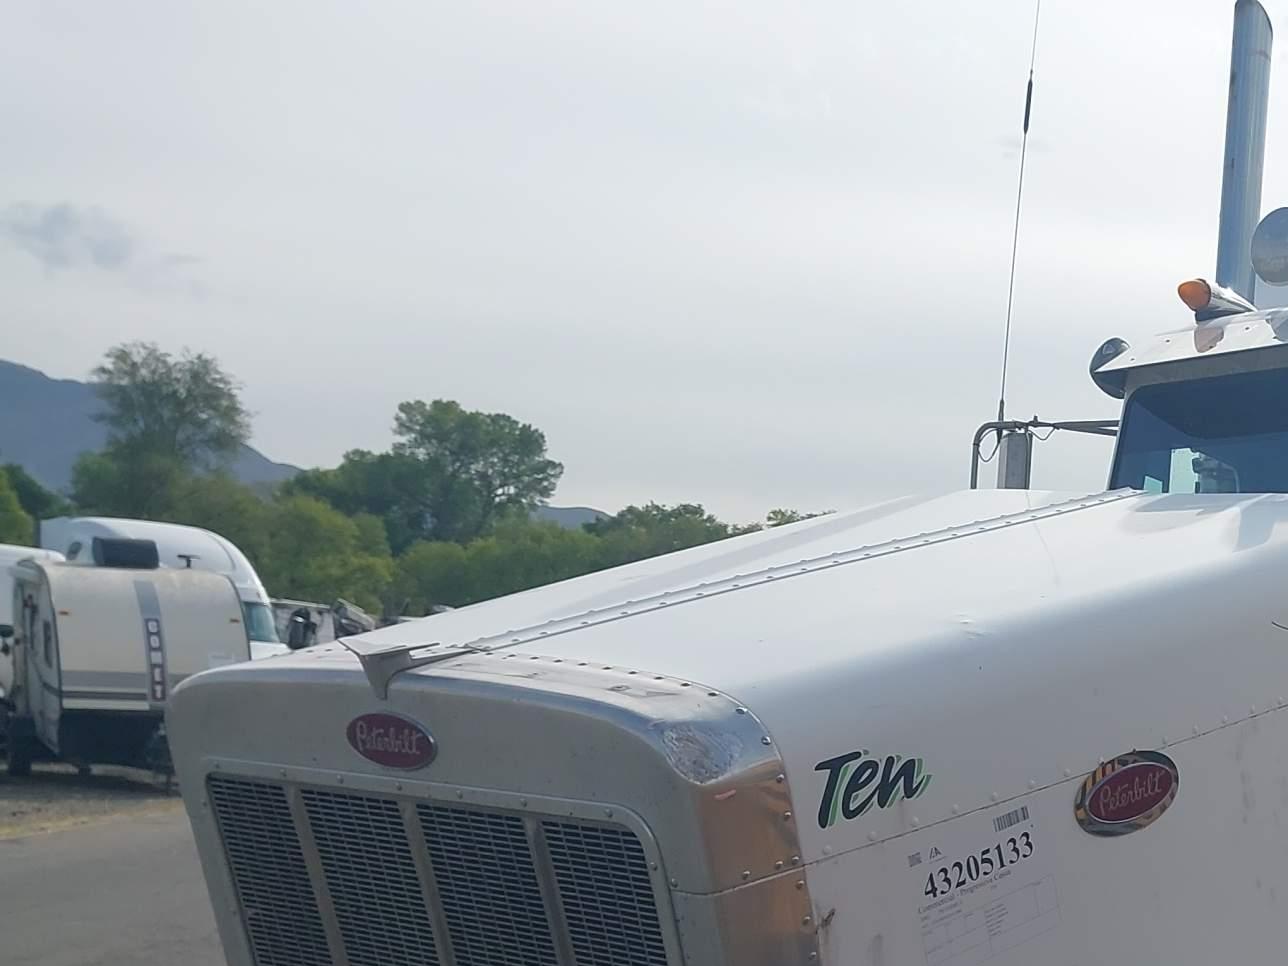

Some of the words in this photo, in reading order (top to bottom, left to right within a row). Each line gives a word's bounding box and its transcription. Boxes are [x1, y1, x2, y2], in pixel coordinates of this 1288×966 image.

[356, 721, 423, 755] Peterbilt
[814, 748, 933, 829] Ten
[1099, 770, 1166, 817] Peterbilt
[924, 831, 1034, 898] 43205133
